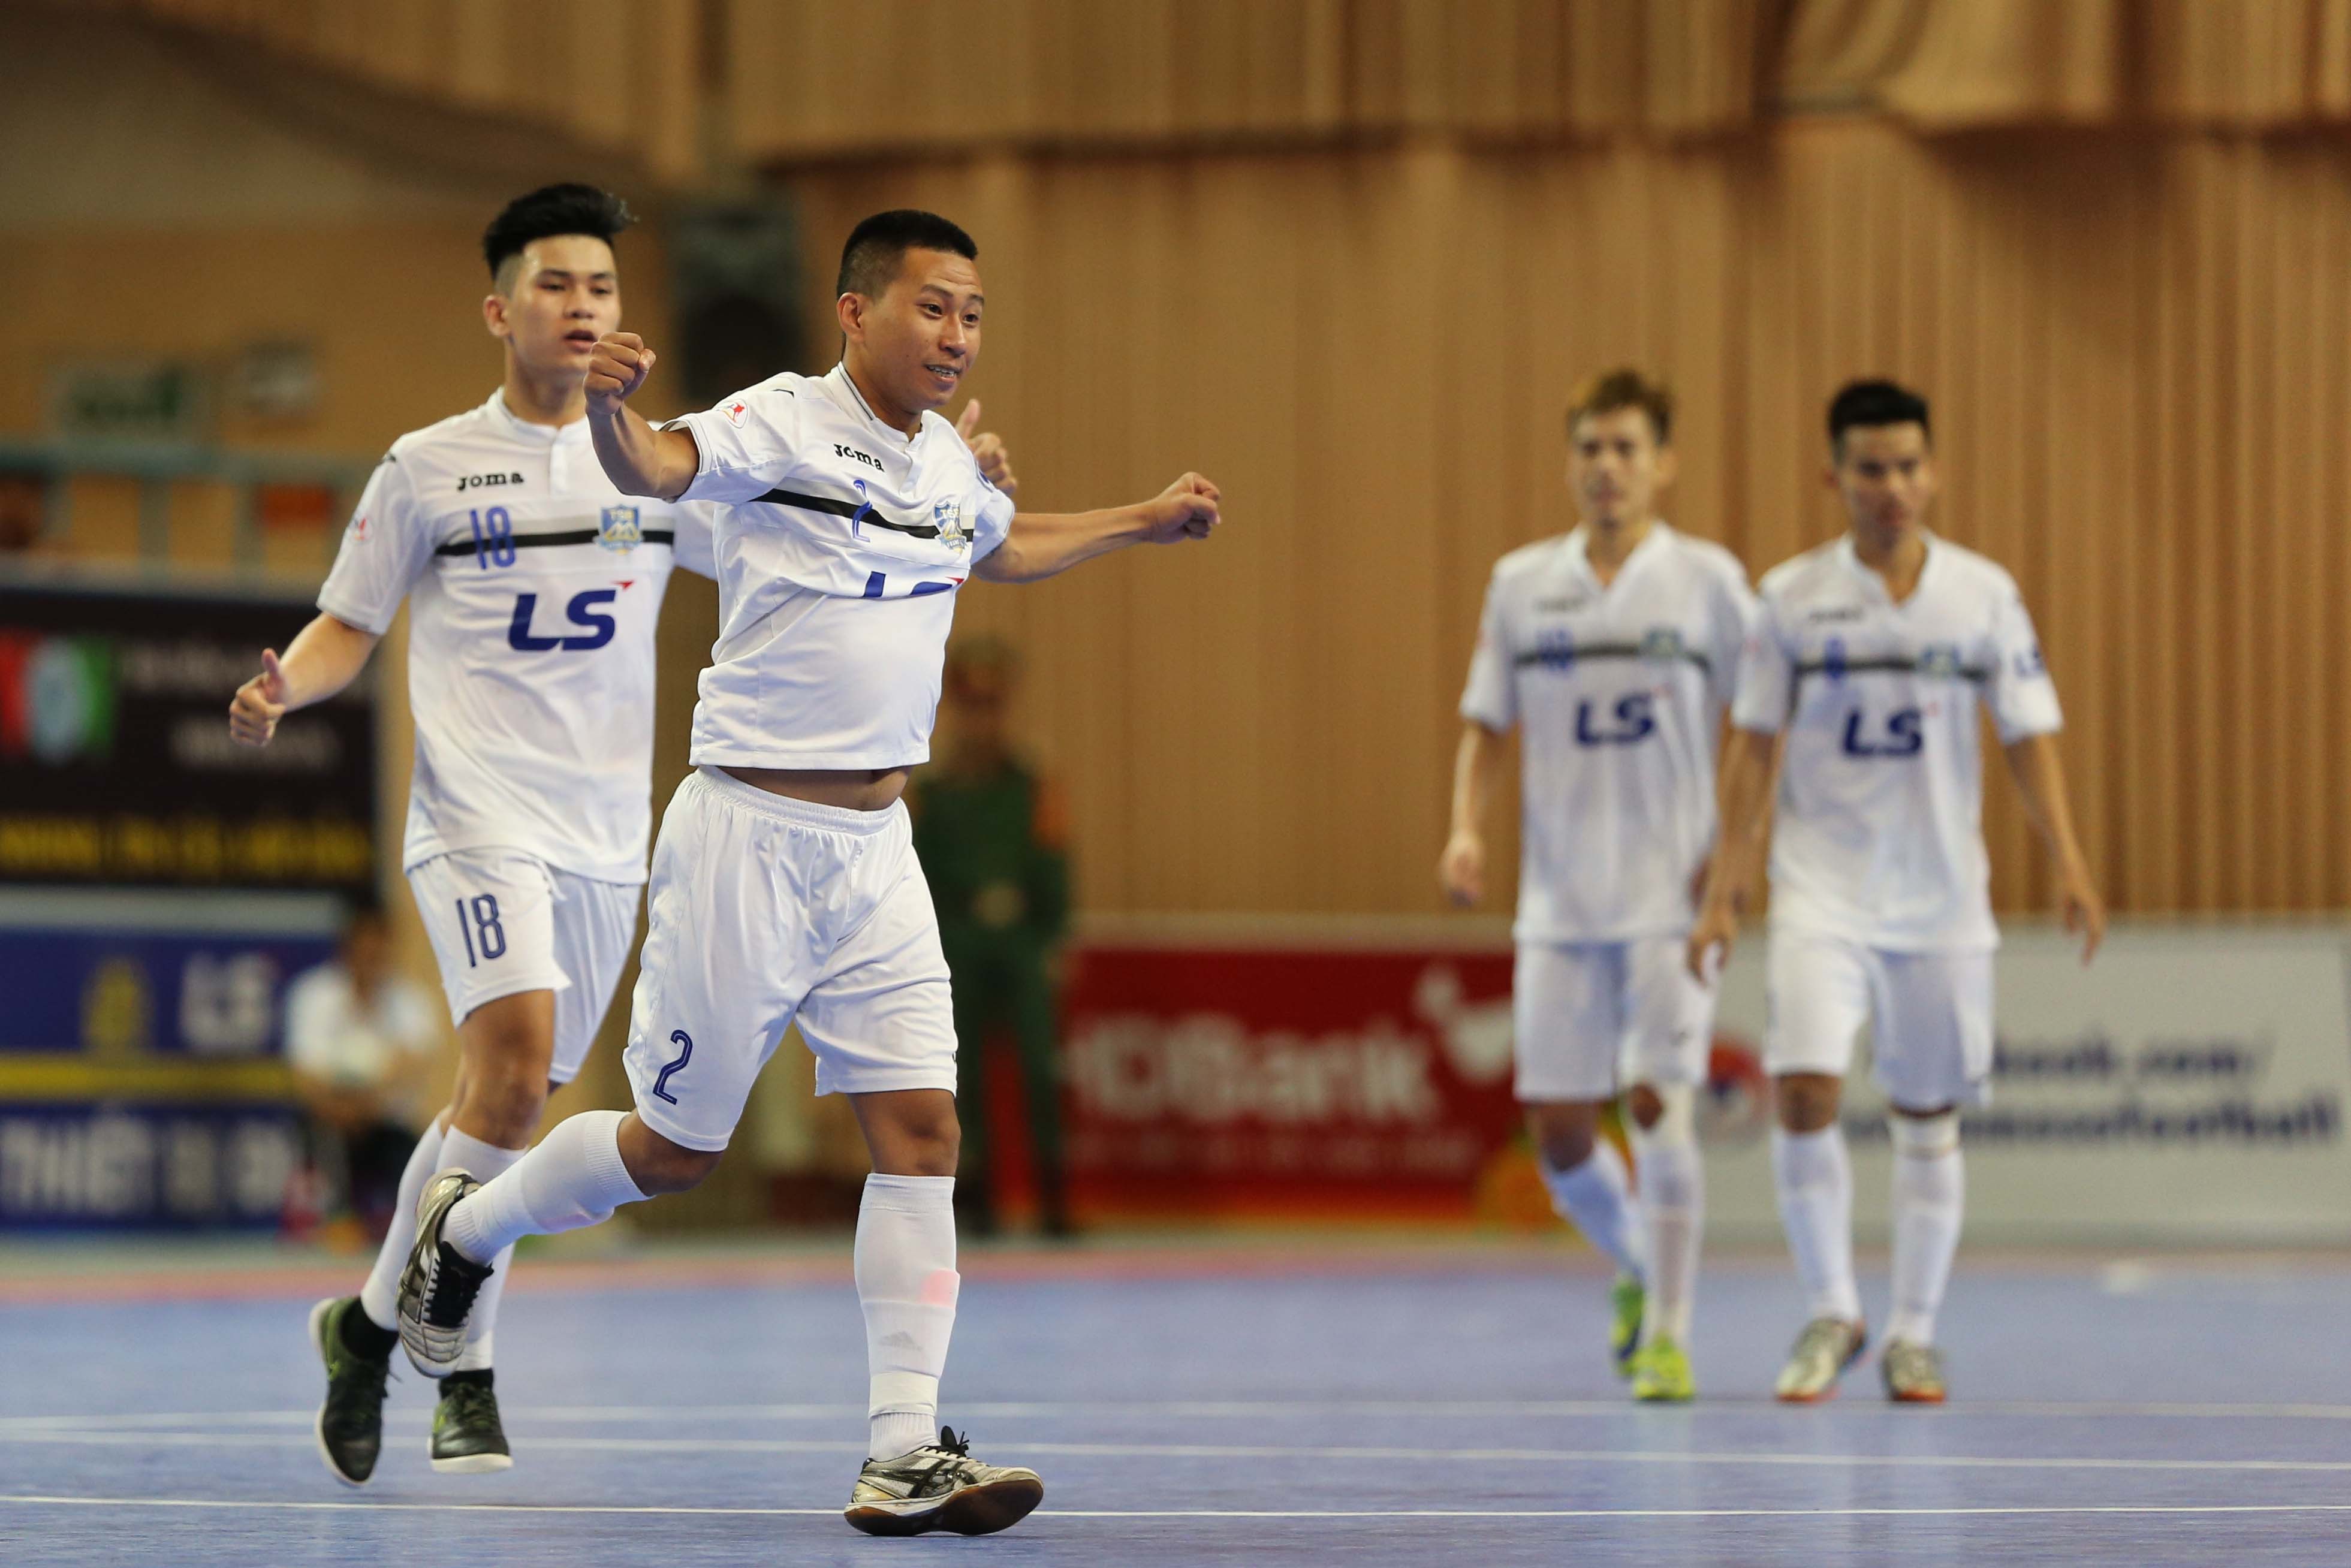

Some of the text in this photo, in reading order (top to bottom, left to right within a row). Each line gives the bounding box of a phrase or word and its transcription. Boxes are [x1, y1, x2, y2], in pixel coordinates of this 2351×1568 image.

[470, 506, 516, 569] 18
[508, 590, 616, 652] LS
[1575, 692, 1656, 746] LS
[1843, 709, 1922, 761] LS
[456, 893, 506, 968] 18
[652, 1029, 693, 1105] 2
